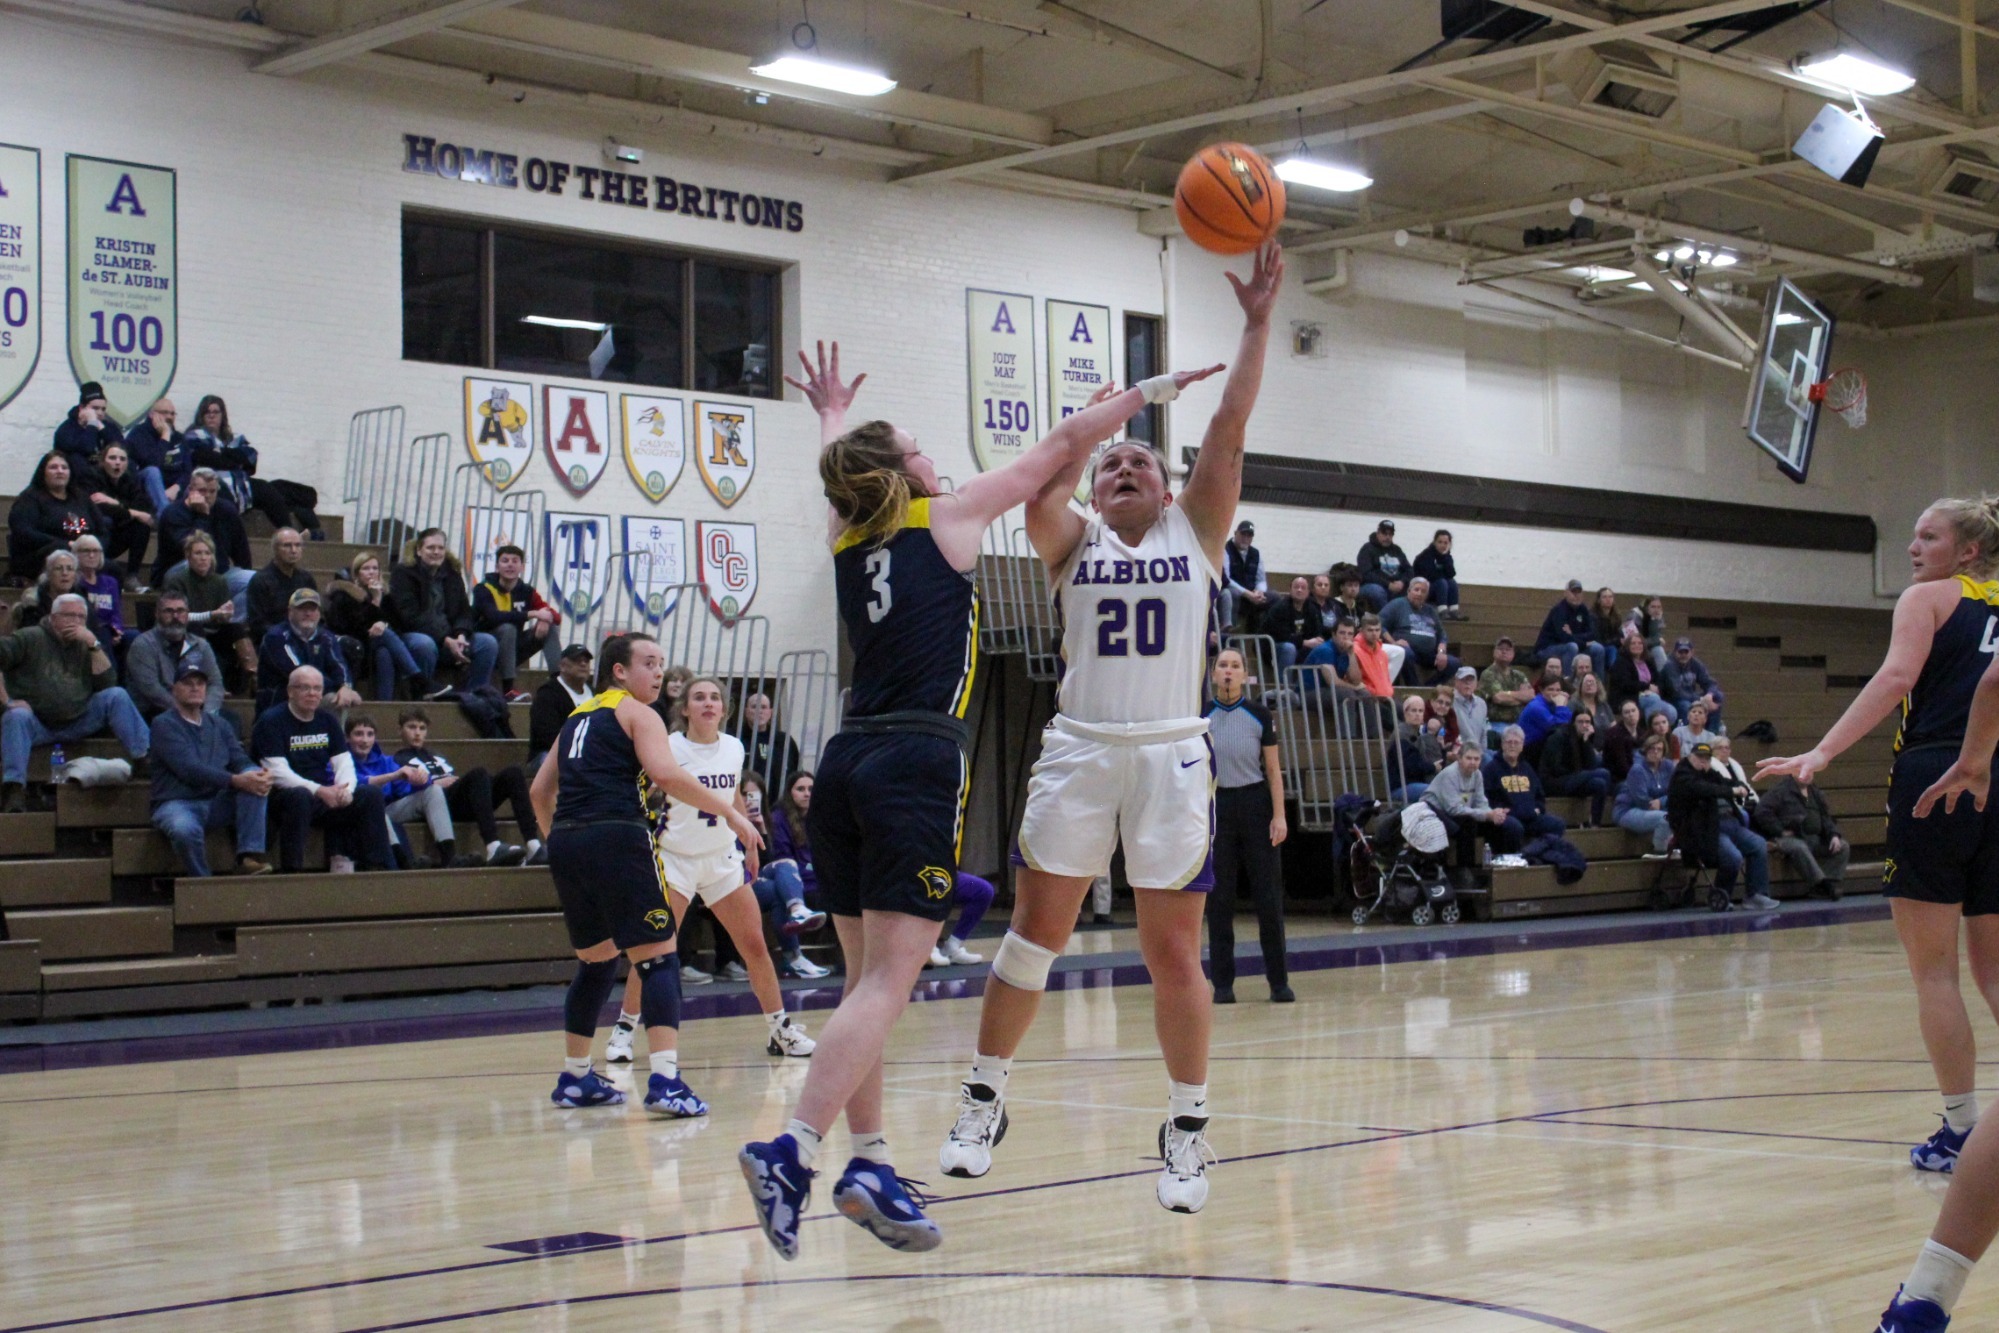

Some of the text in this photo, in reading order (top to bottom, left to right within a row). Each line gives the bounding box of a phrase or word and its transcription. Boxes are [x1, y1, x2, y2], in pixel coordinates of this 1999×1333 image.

[105, 173, 147, 217] A
[403, 133, 804, 233] HOME OF THE BRITONS
[95, 237, 156, 256] KRISTIN
[82, 268, 169, 290] de ST. AUBIN
[991, 301, 1016, 334] A
[1070, 311, 1093, 344] A
[89, 310, 163, 357] 100
[103, 356, 150, 375] WINS
[992, 352, 1017, 366] JODY
[994, 366, 1016, 379] MAY
[1069, 357, 1095, 370] MIKE
[1062, 370, 1102, 384] TURNER
[556, 396, 602, 455] A
[984, 398, 1030, 432] 150
[477, 416, 509, 447] A
[638, 439, 676, 449] CALVIN
[707, 411, 748, 467] K
[992, 432, 1022, 447] WINS
[632, 447, 681, 458] KNIGHTS
[560, 519, 598, 569] T
[635, 541, 676, 554] SAINT
[865, 548, 892, 624] 3
[1072, 555, 1190, 586] ALBION
[1097, 598, 1167, 657] 20
[568, 715, 590, 759] 11
[697, 773, 736, 789] BION
